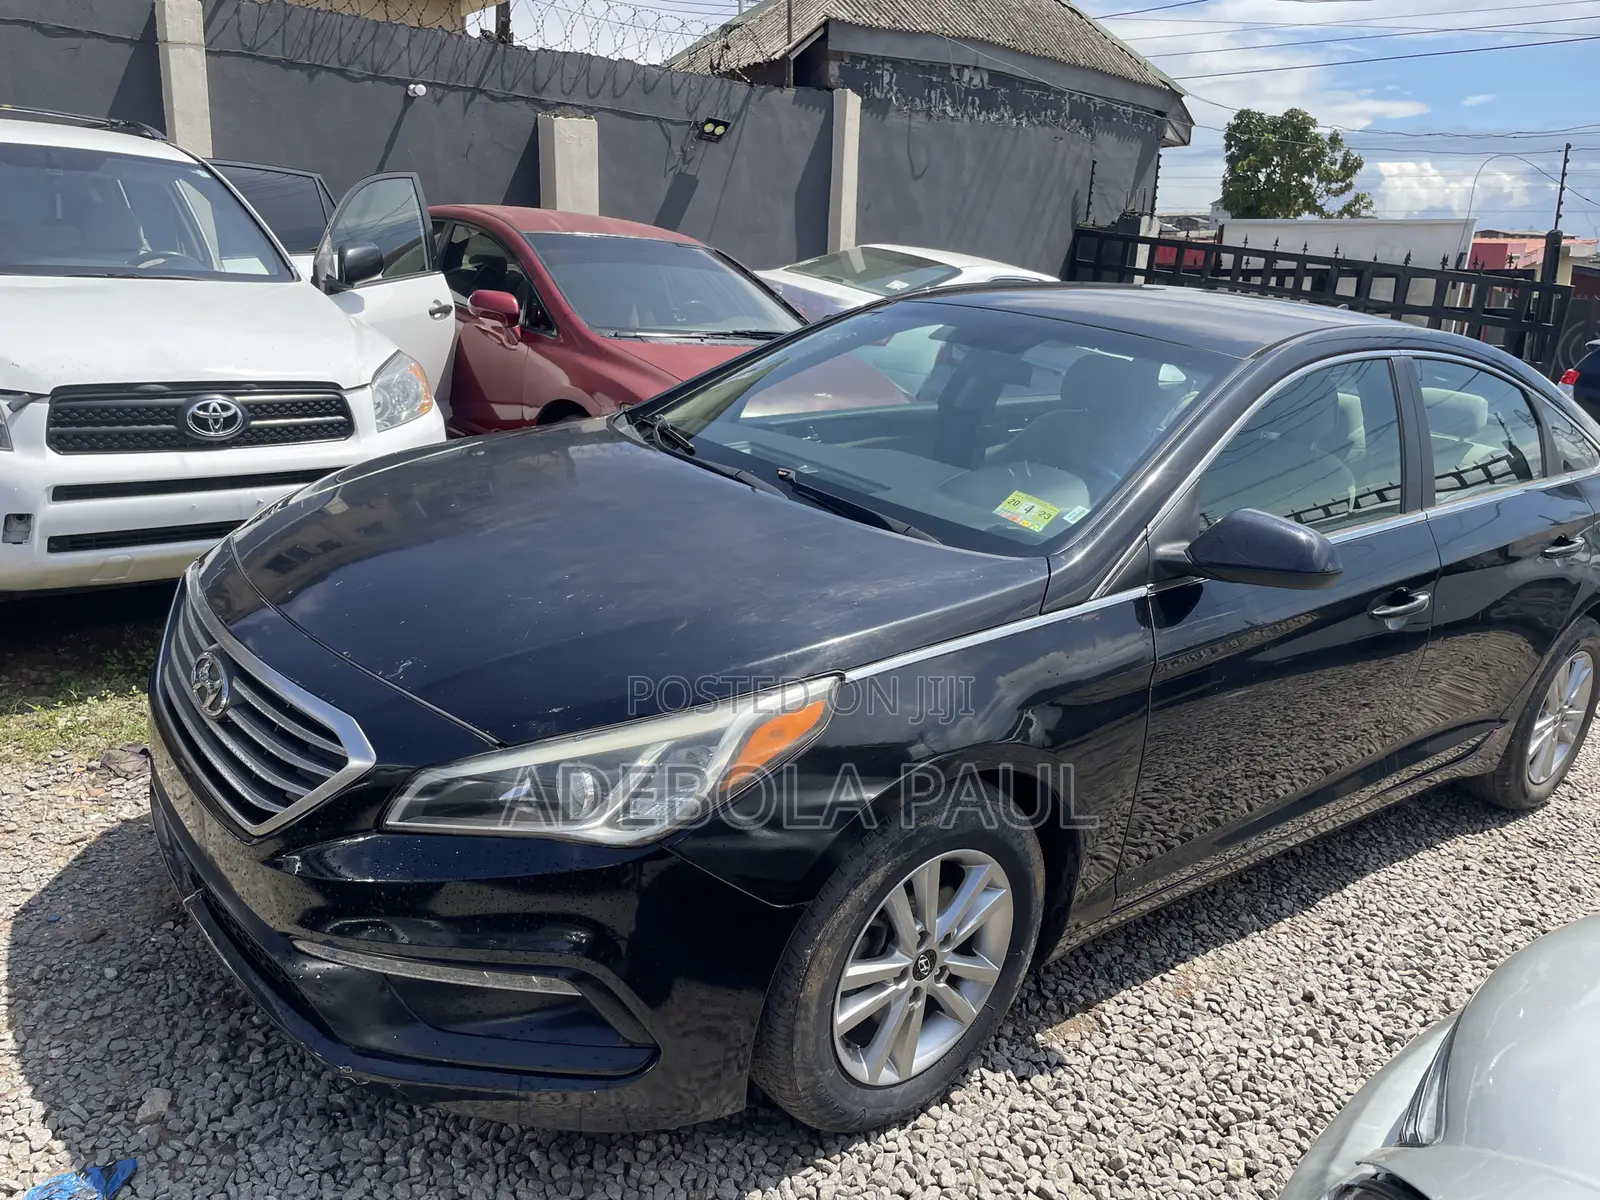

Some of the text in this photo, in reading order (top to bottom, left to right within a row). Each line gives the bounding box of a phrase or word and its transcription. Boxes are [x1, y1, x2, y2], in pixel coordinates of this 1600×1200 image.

[1007, 498, 1021, 507] 20
[1024, 505, 1036, 514] 4
[1038, 510, 1052, 520] 23
